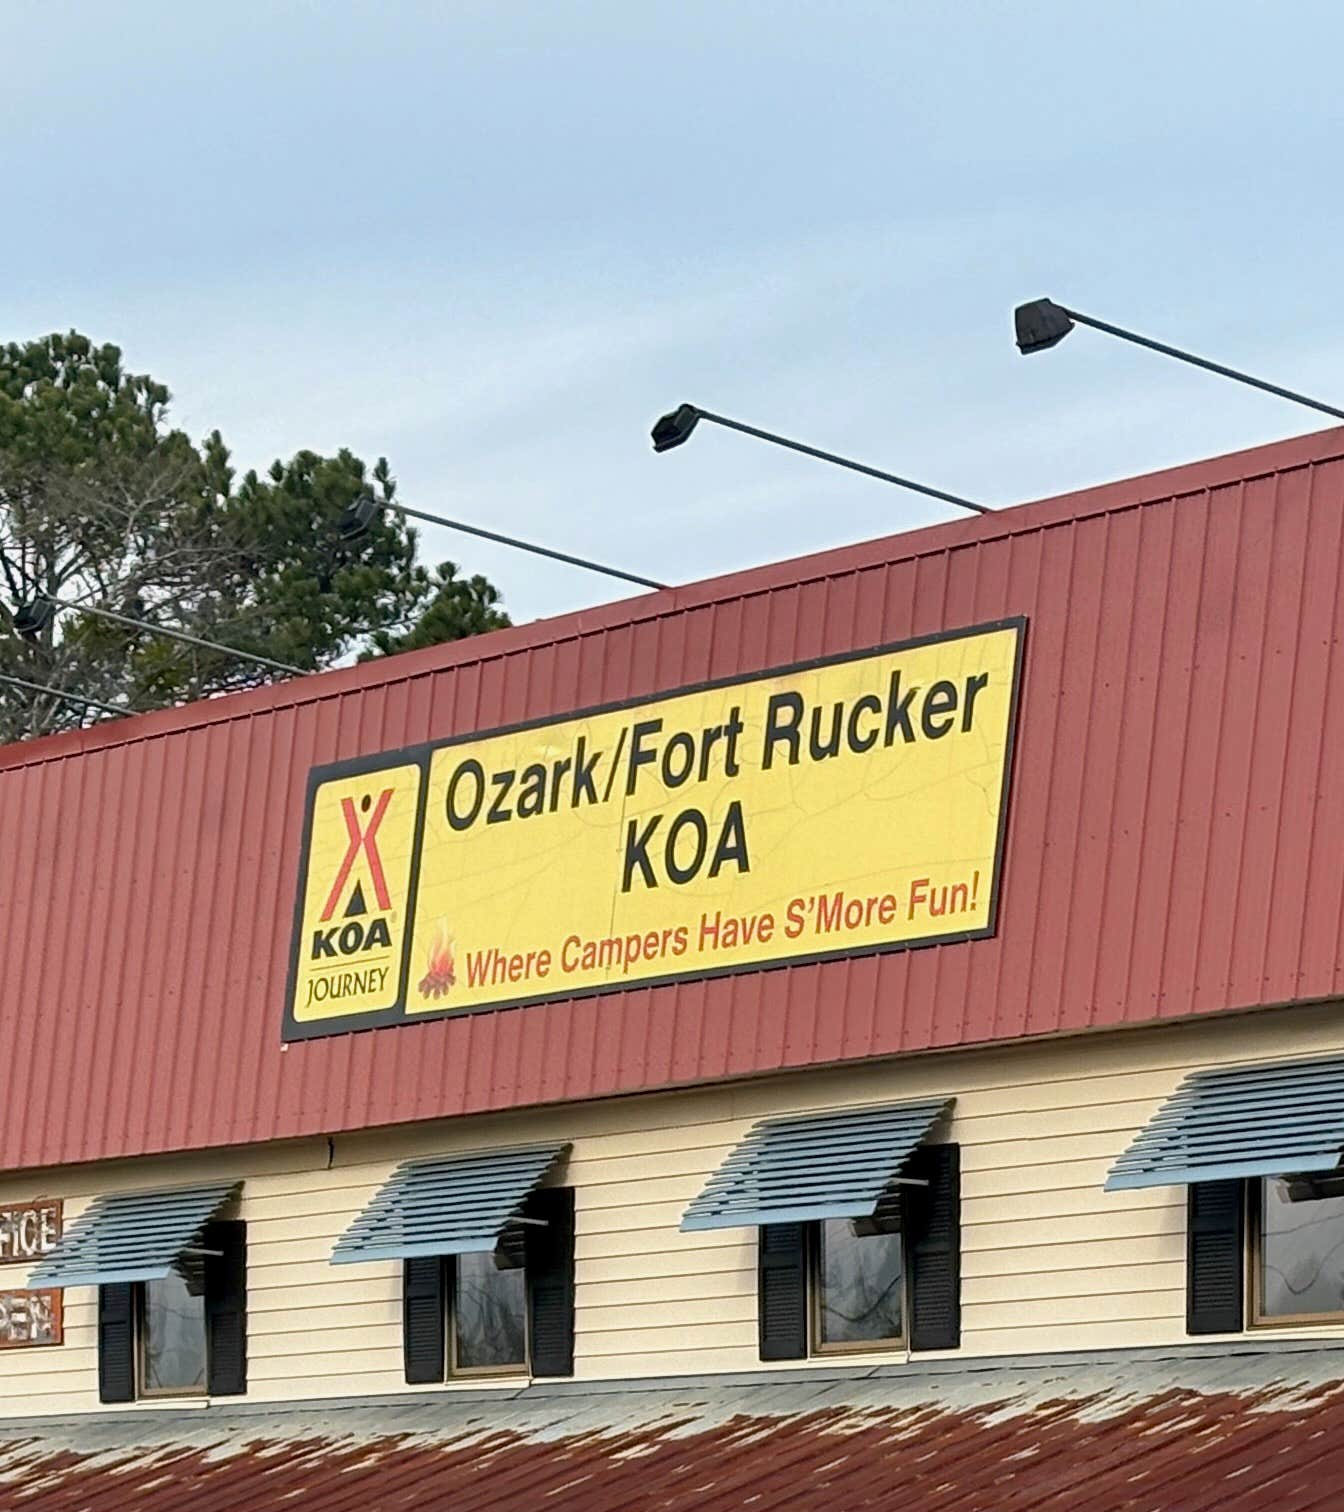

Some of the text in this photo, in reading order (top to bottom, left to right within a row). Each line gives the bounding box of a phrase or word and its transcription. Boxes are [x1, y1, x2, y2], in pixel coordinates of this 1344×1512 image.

[445, 669, 989, 832] Ozark/Fort Rucker
[621, 800, 751, 893] KOA
[311, 917, 392, 961] KOA
[466, 870, 980, 989] Where Campers Have S'More Fun!
[305, 966, 390, 1008] JOURNEY
